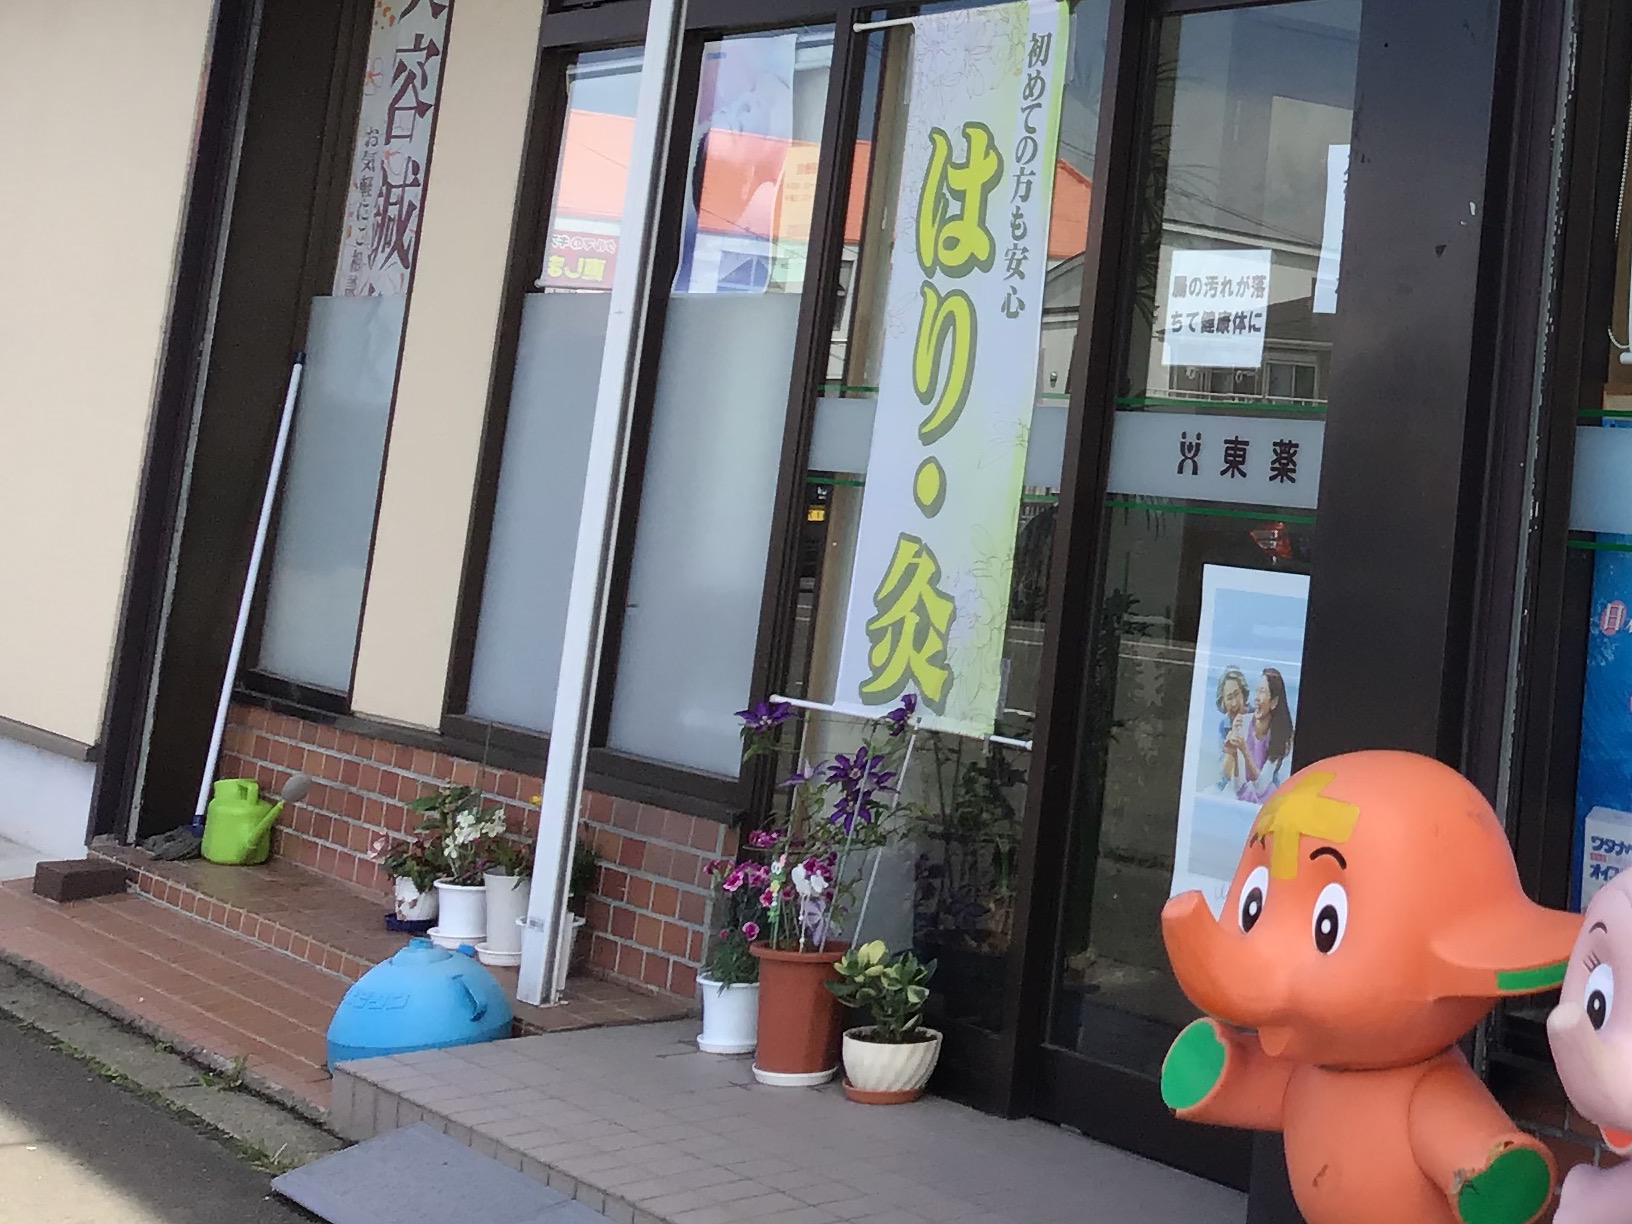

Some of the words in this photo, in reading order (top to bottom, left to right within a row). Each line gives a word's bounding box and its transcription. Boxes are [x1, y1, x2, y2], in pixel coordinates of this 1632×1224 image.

[1000, 32, 1052, 319] 初めての方も安心
[1171, 310, 1263, 335] ちて健康体に
[860, 120, 1005, 706] はり・灸
[1220, 435, 1299, 483] 東薬
